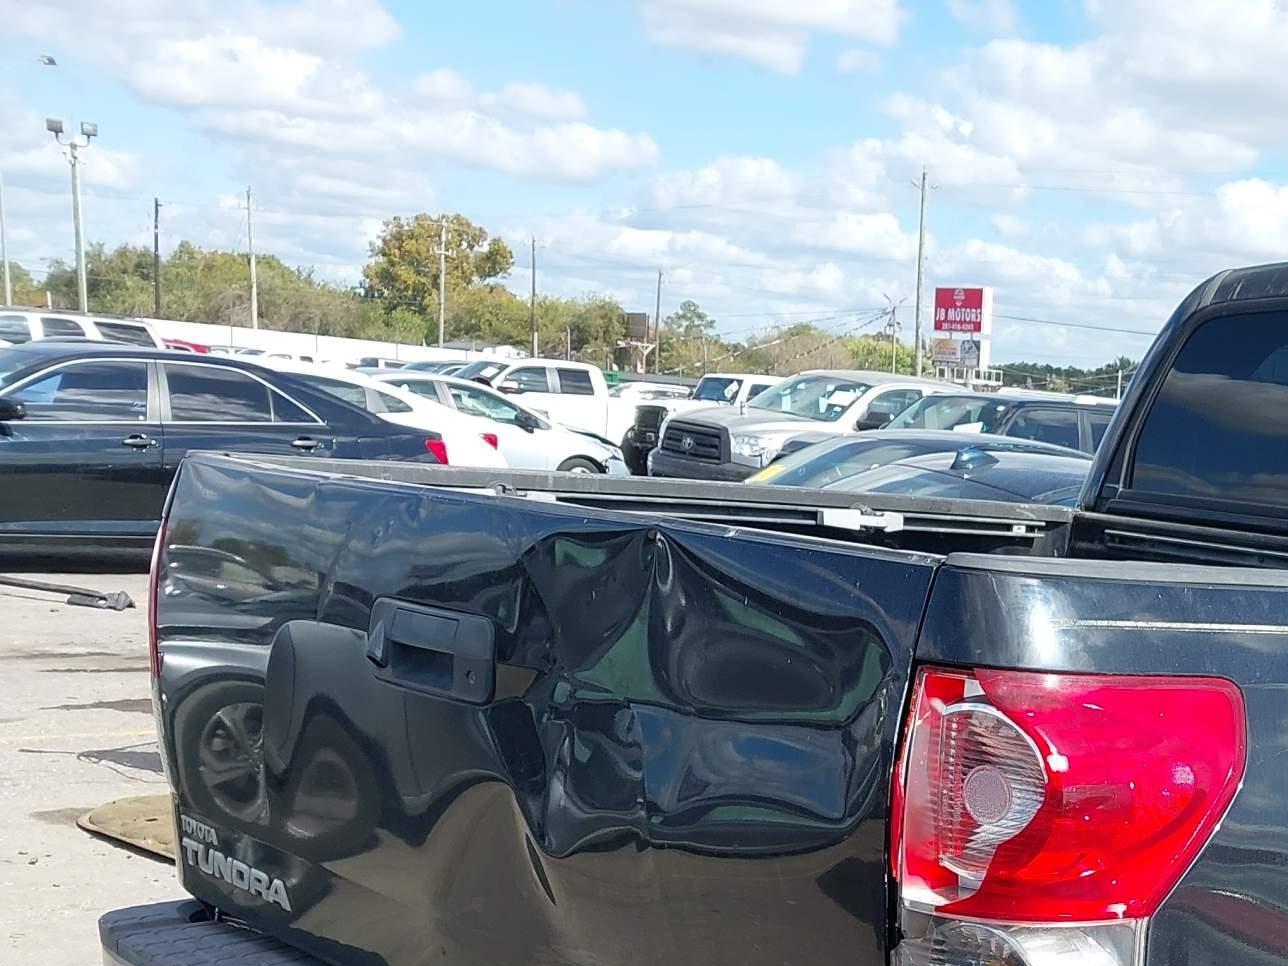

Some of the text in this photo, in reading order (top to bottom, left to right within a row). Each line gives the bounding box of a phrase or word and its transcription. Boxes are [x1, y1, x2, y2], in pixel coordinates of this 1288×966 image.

[936, 307, 981, 323] JB MOTORS
[180, 814, 218, 846] TOYOTA
[182, 836, 292, 912] TUNDRA
